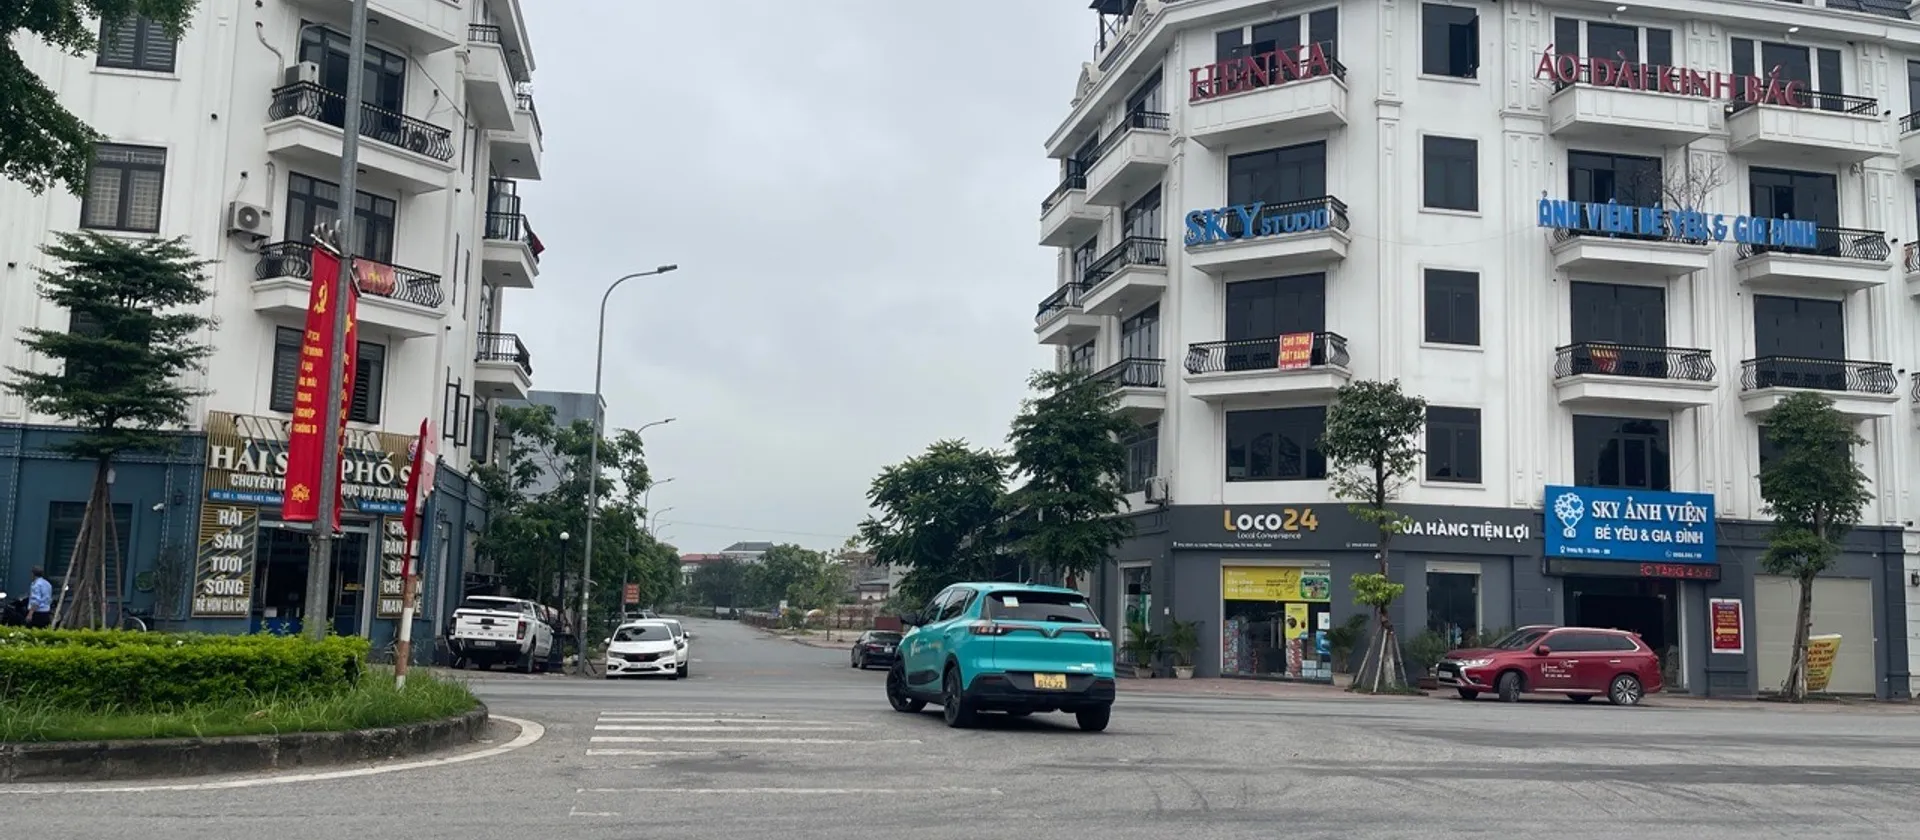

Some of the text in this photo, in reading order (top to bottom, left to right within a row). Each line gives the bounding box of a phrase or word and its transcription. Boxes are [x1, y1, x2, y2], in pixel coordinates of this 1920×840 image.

[1189, 41, 1330, 102] HENNA
[1536, 43, 1807, 108] ÁO DÀI KINH BẮC
[1184, 201, 1329, 246] SKY STUDIO
[1713, 214, 1728, 241] &
[1733, 215, 1767, 245] GIA
[1770, 213, 1817, 248] ĐÌNH
[209, 439, 268, 475] HẢI
[341, 452, 395, 485] PHỐ
[230, 471, 276, 490] CHUYÊN
[392, 488, 409, 501] NH
[217, 507, 243, 526] HẢI
[1224, 508, 1318, 531] Loco24
[1592, 496, 1708, 527] SKY ẢNH VIỆN
[214, 530, 243, 549] SẢN
[1237, 531, 1301, 540] Local Convenience
[1426, 518, 1469, 537] HÀNG
[1471, 521, 1503, 541] TIỆN
[1505, 524, 1529, 543] LỢI
[1595, 526, 1704, 545] BÉ YÊU & GIA ĐÌNH
[205, 574, 244, 595] SỐNG
